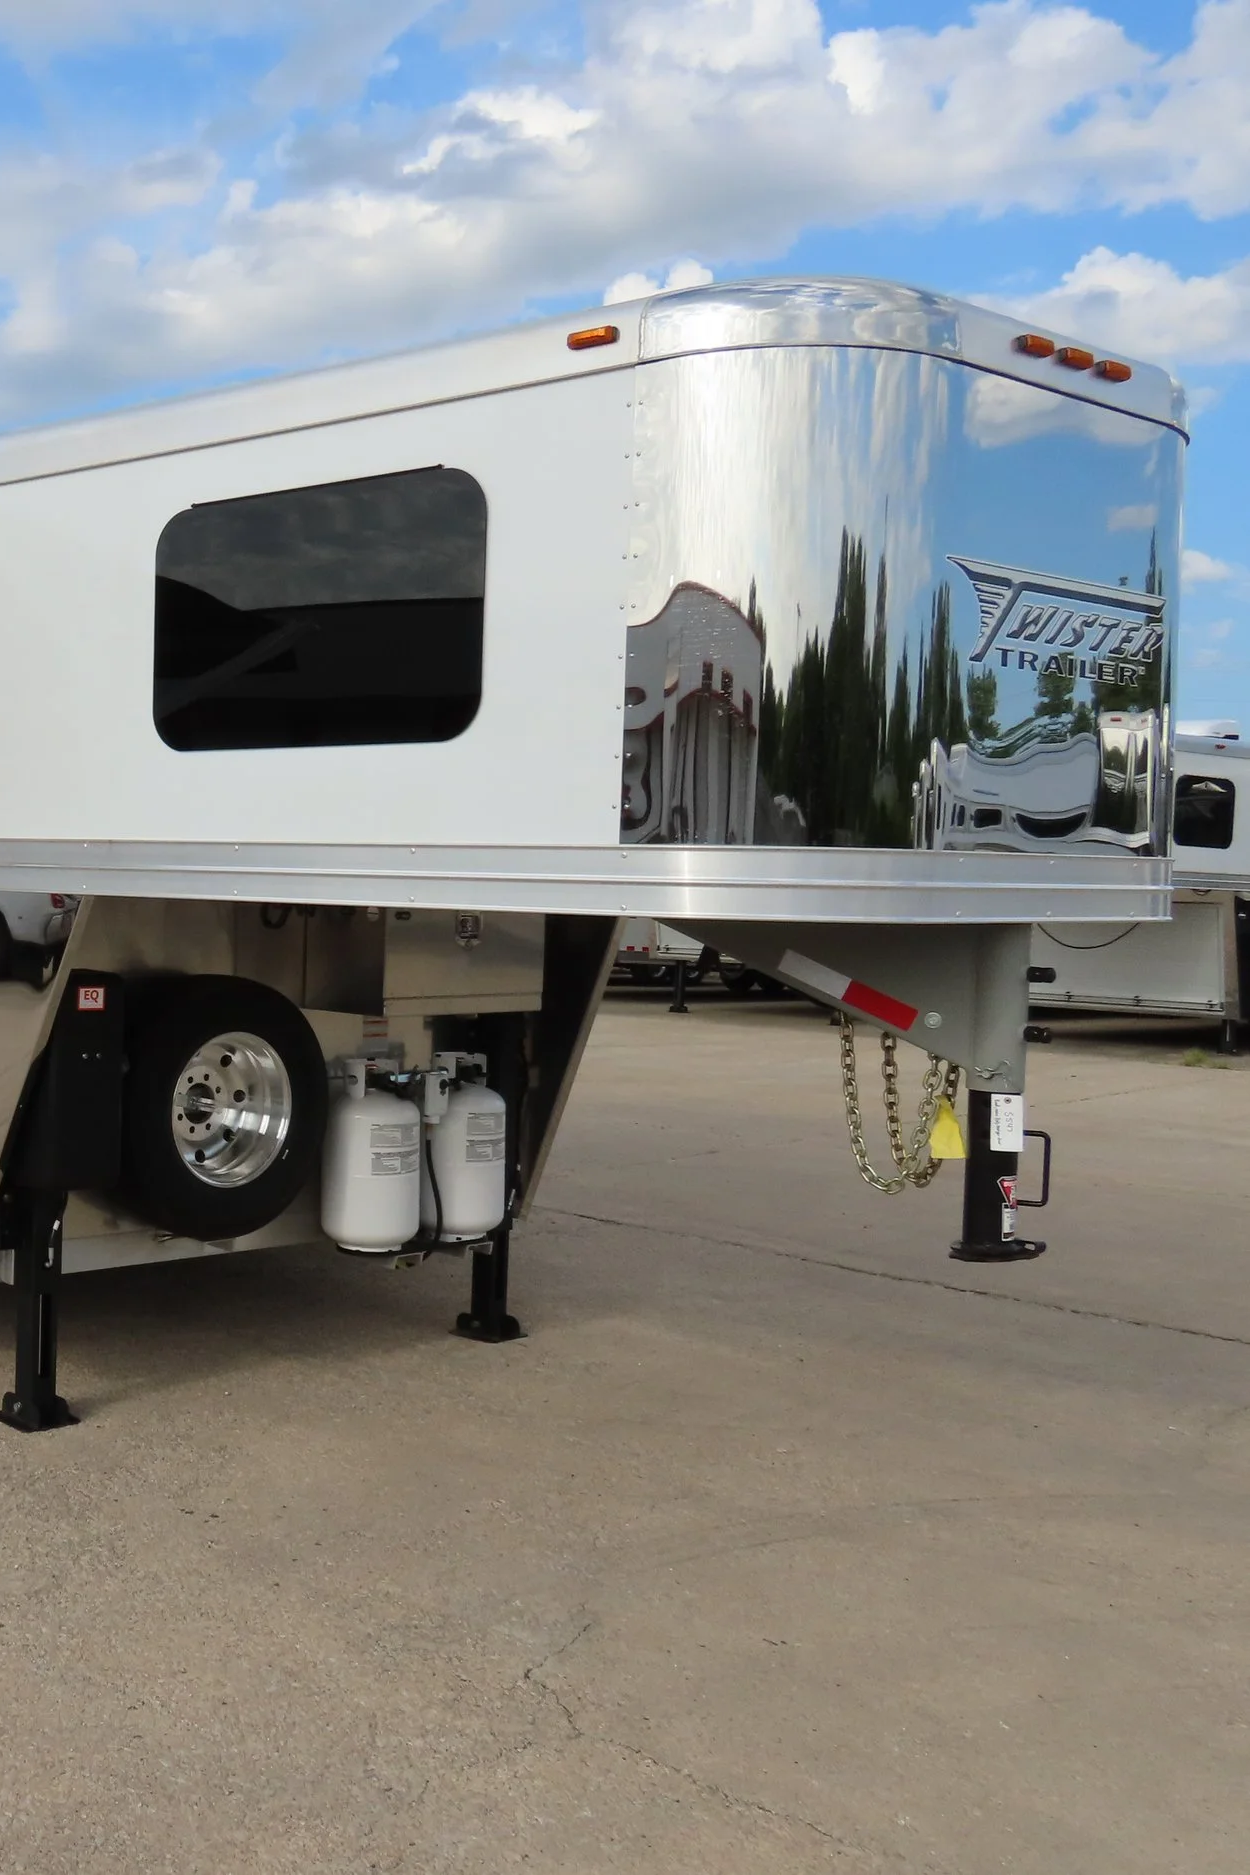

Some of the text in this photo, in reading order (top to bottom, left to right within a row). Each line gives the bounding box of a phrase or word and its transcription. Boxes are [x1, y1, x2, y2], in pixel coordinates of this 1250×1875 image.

[946, 555, 1166, 663] TWISTER
[995, 647, 1139, 687] TRAILER
[84, 990, 99, 1003] EQ
